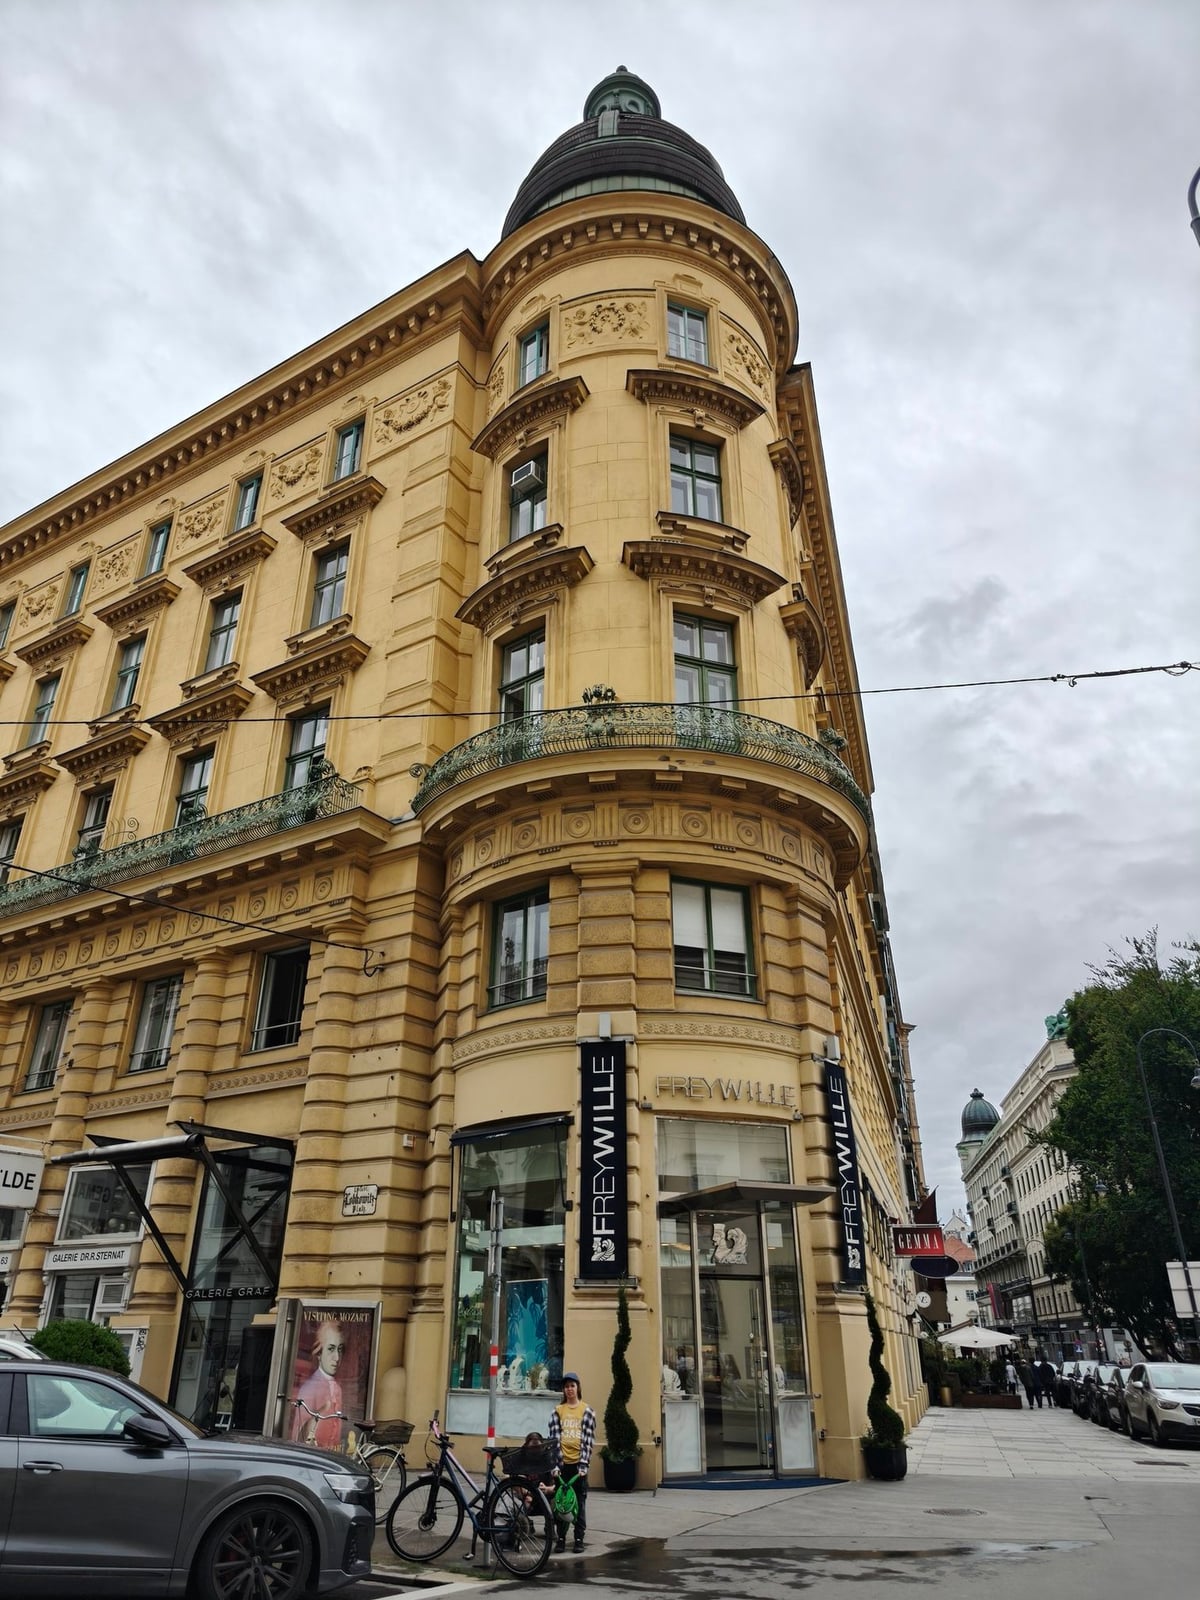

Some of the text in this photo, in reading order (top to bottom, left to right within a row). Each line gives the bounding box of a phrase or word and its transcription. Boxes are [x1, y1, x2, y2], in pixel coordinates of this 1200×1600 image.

[656, 1076, 796, 1108] FREYWILLE
[592, 1055, 615, 1235] FREYWILLE
[829, 1075, 860, 1245] FREYWILLE
[0, 1169, 37, 1190] LDE
[898, 1233, 939, 1250] GEMMA
[52, 1252, 79, 1263] GALERIE
[185, 1286, 271, 1299] GALERIE GRAF
[303, 1311, 370, 1323] VISITING MOZART
